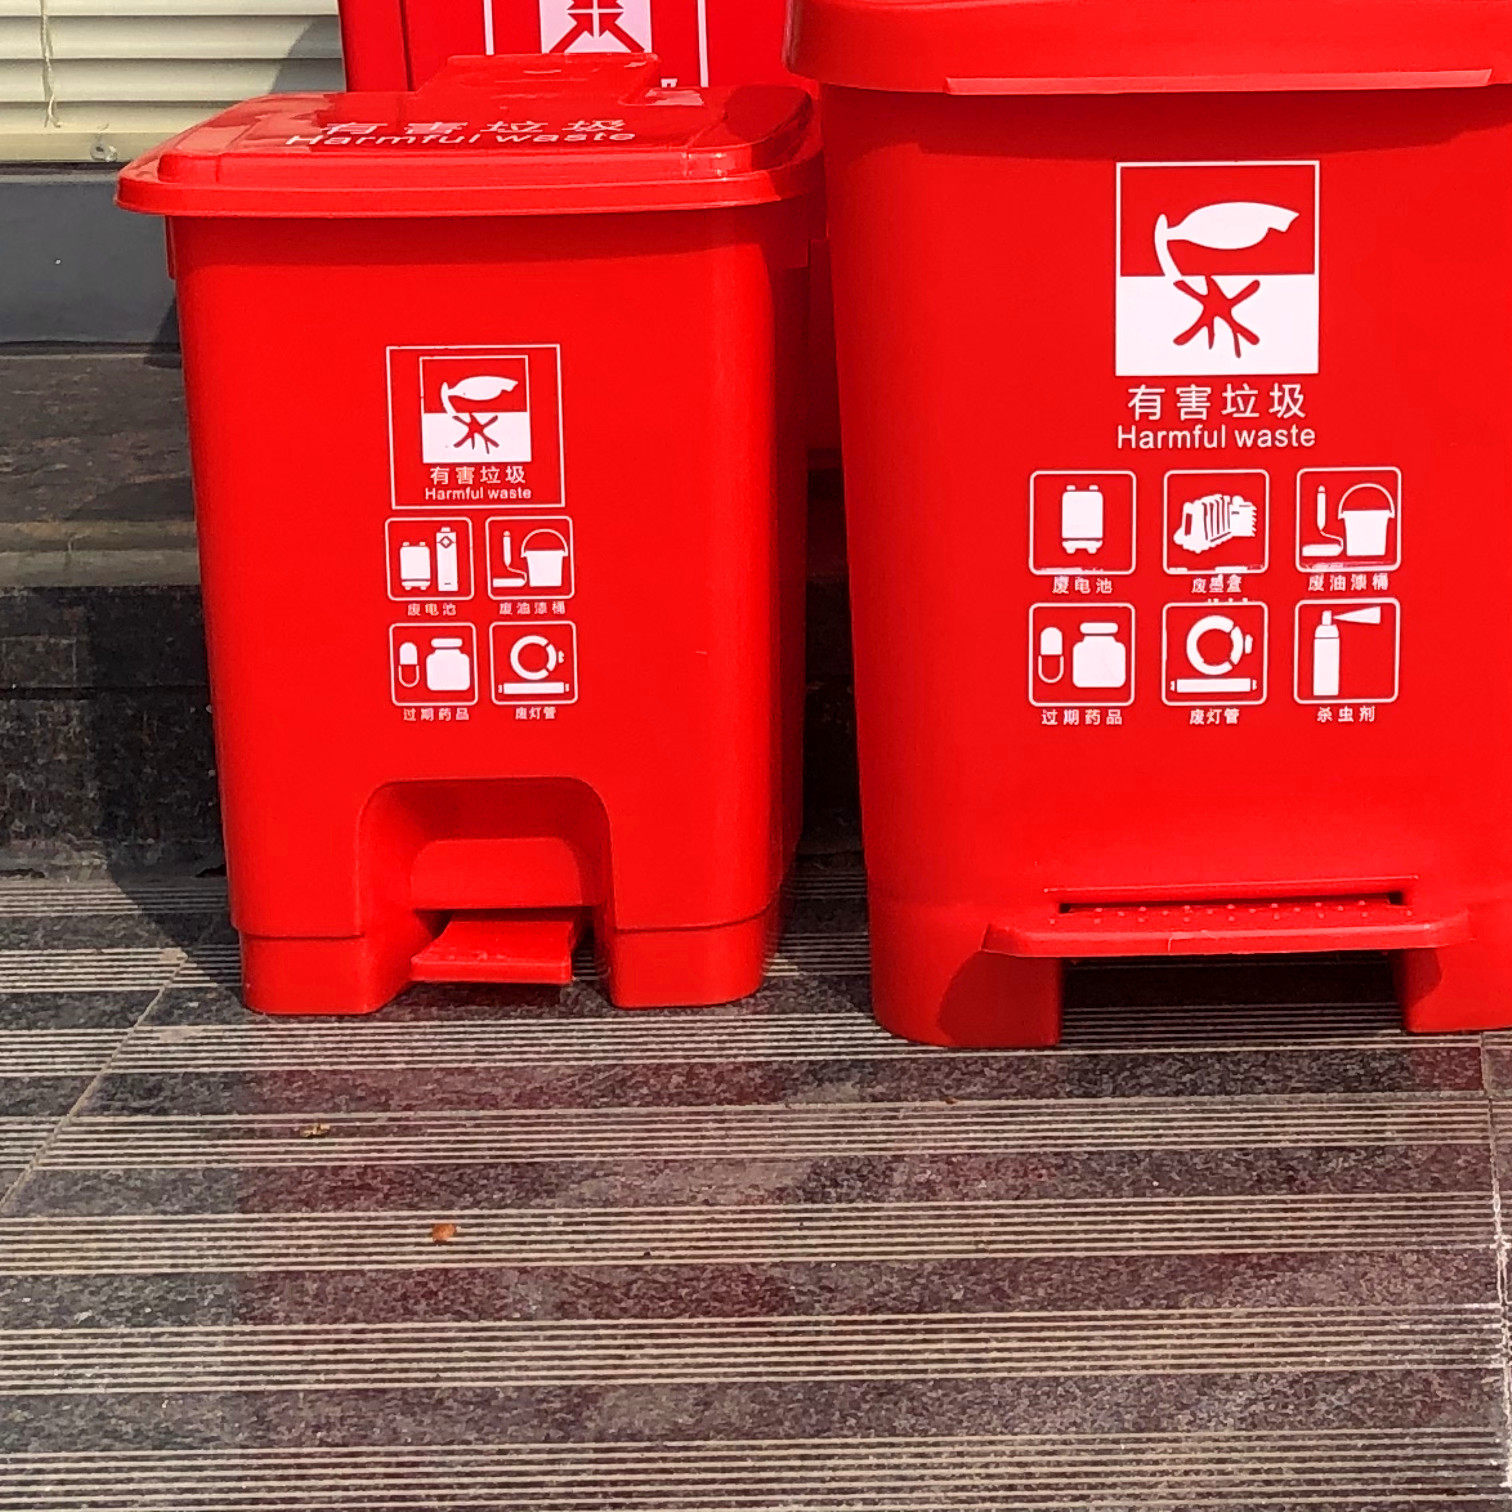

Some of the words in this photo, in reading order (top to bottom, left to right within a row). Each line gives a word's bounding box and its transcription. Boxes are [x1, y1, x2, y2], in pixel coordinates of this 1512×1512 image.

[320, 120, 626, 135] 有害垃圾
[284, 133, 481, 145] Harmful
[496, 132, 635, 143] waste
[1128, 383, 1305, 421] 有害垃圾
[1118, 424, 1225, 448] Harmful
[1235, 424, 1315, 447] waste
[430, 466, 525, 484] 有害垃圾
[426, 487, 483, 500] Harmful
[488, 487, 531, 498] waste
[1052, 576, 1112, 593] 废电池
[1308, 572, 1388, 591] 废油漆桶
[1042, 709, 1122, 725] 过期药品
[1190, 708, 1239, 724] 废灯管
[1317, 706, 1375, 722] 杀虫剂
